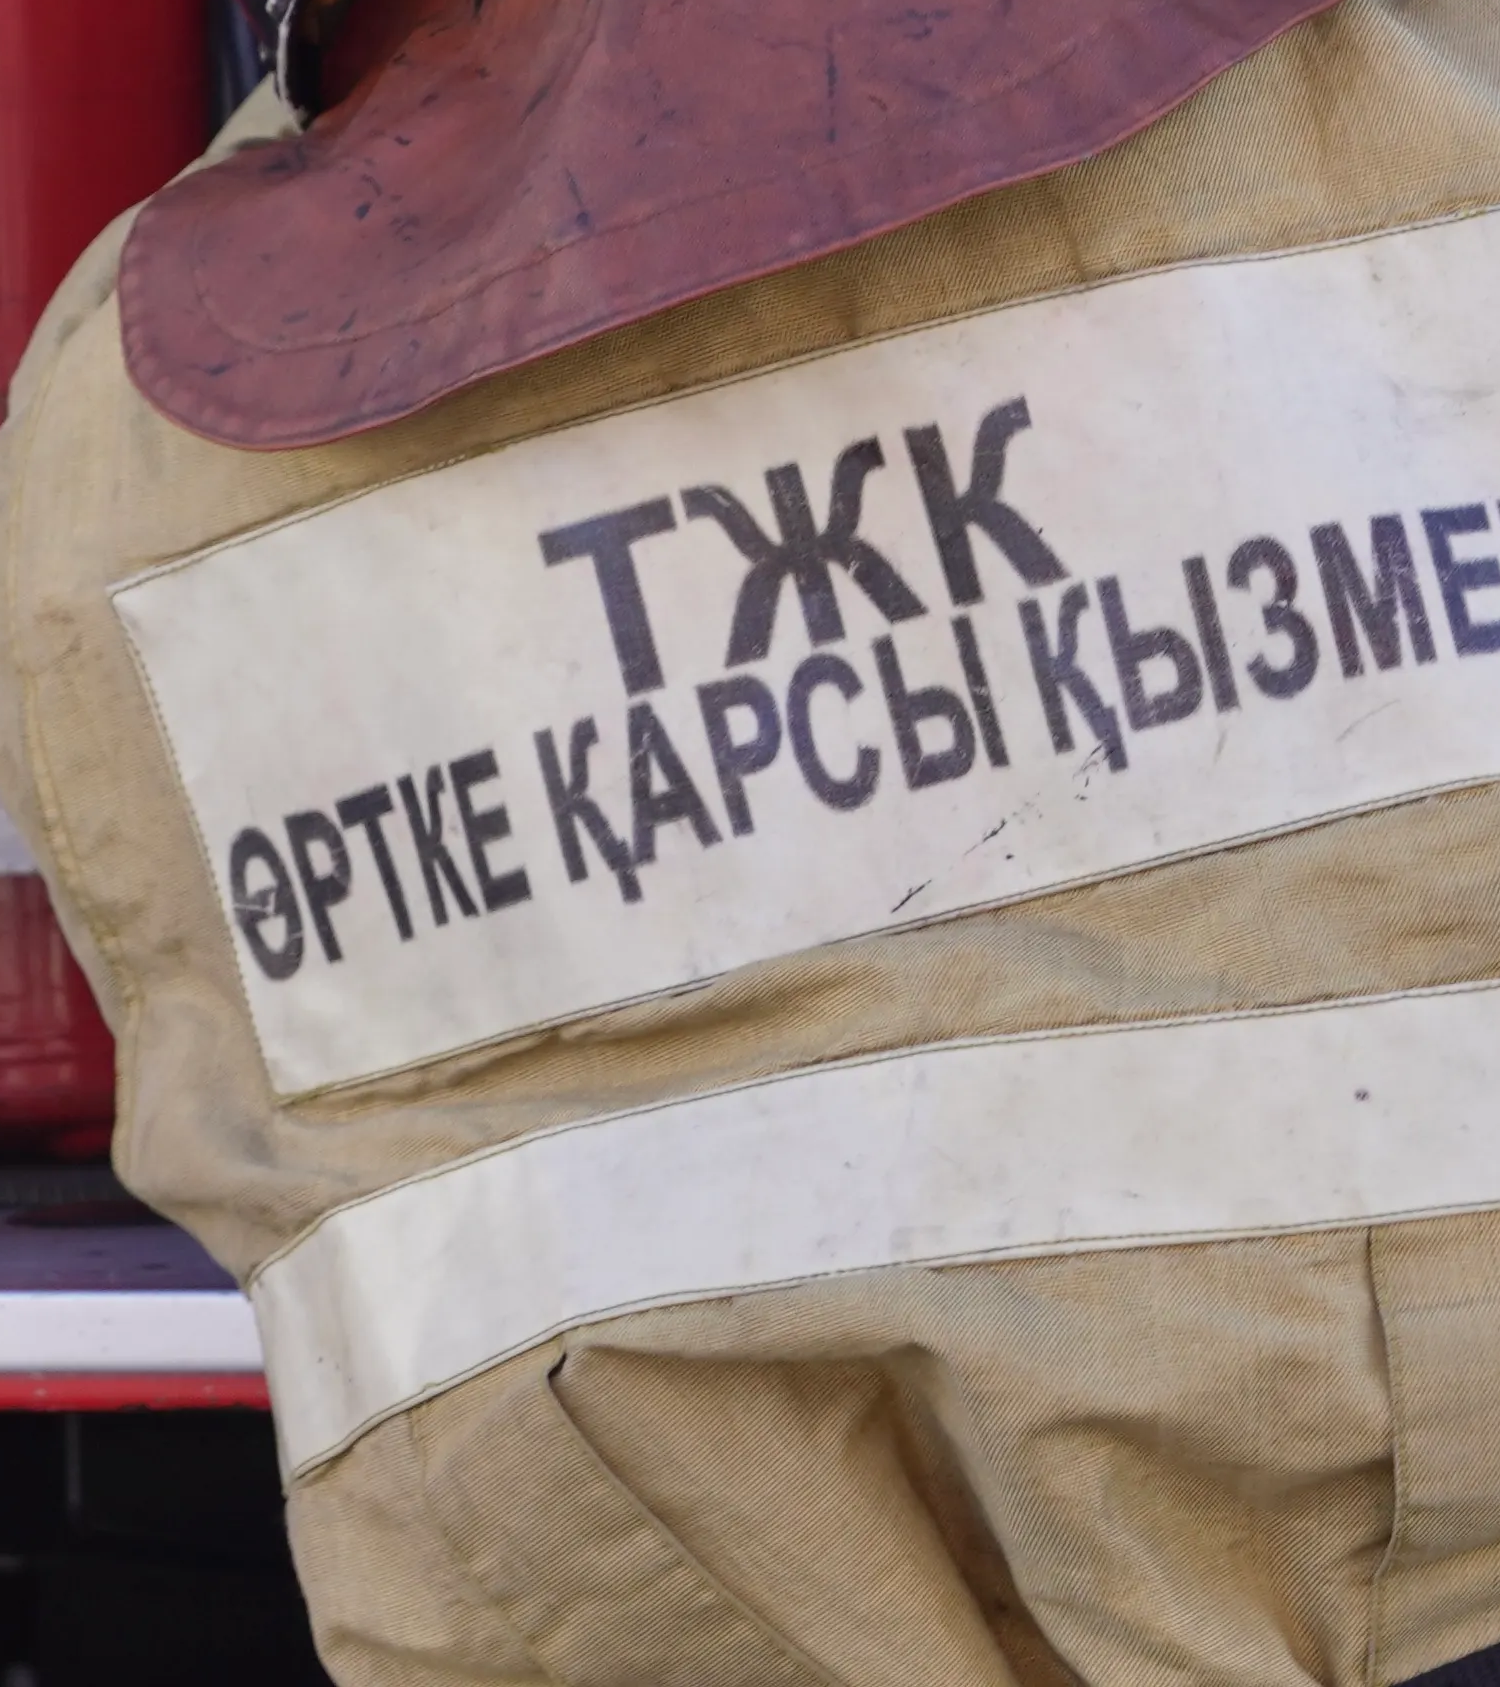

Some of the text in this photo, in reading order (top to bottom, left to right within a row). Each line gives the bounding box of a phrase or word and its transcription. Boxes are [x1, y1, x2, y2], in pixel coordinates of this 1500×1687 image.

[538, 395, 1070, 693] ТЖК
[226, 747, 532, 981] ӨРТКЕ
[533, 615, 1011, 903] ҚАРСЫ
